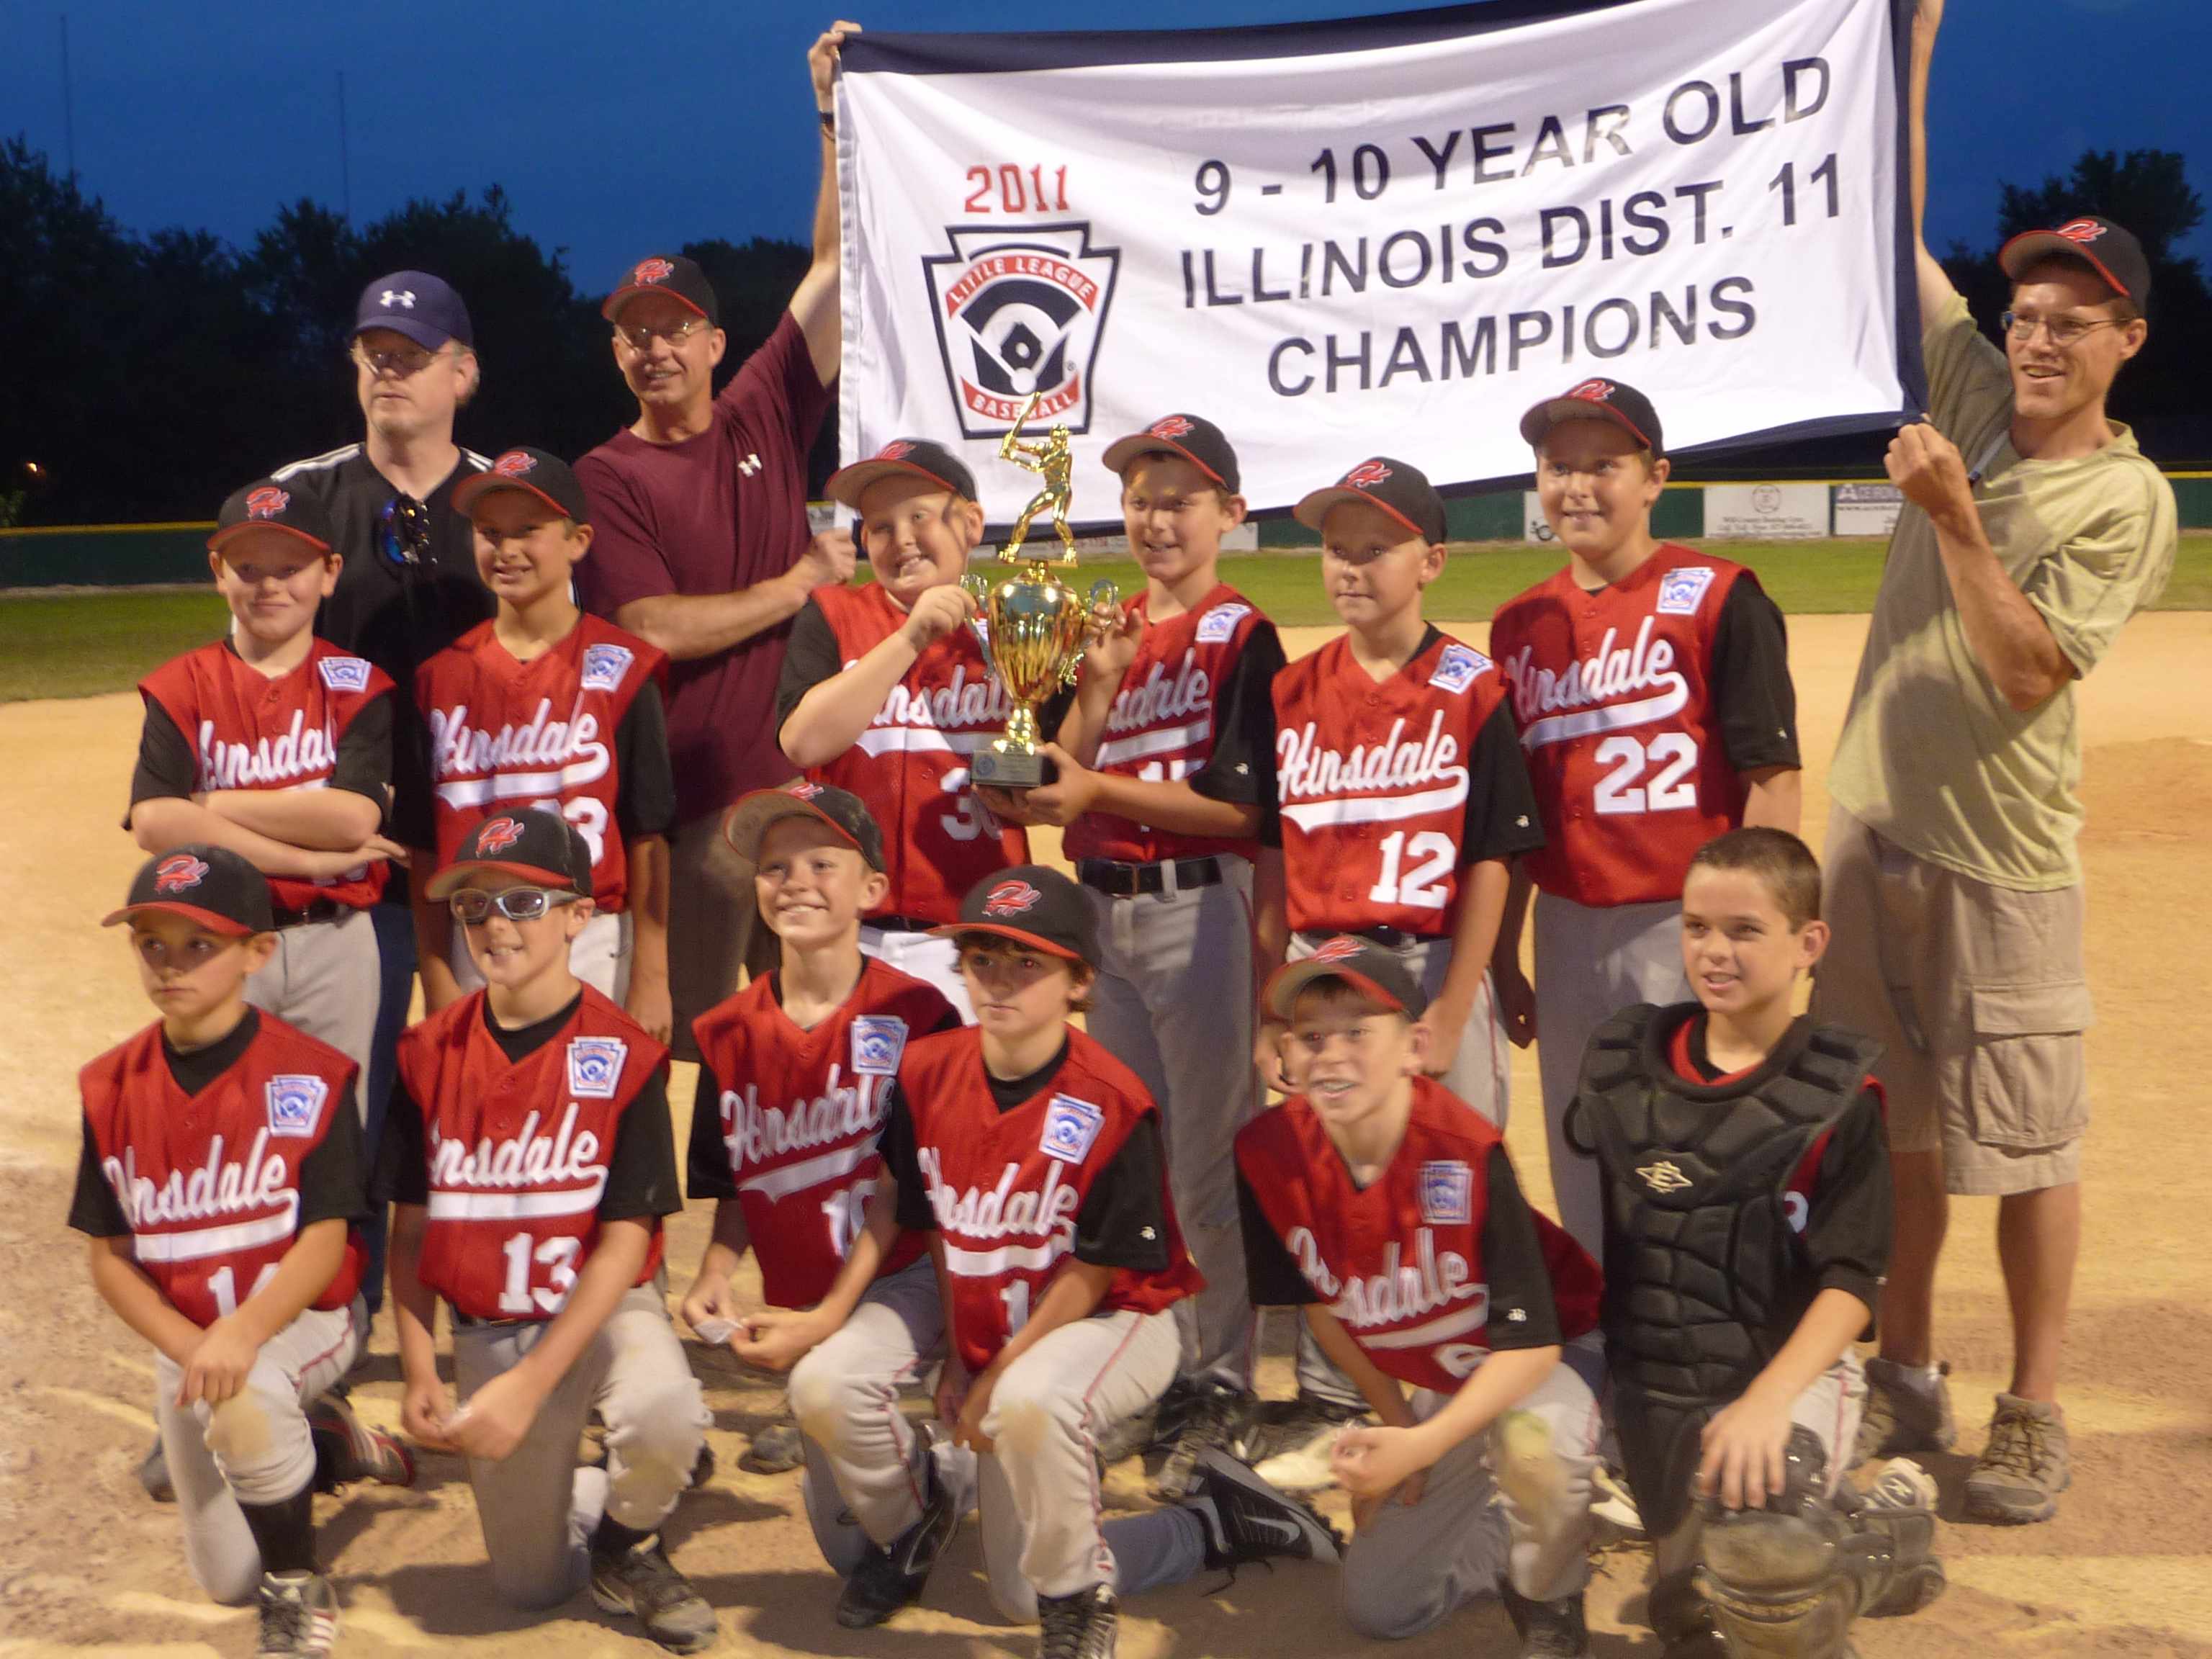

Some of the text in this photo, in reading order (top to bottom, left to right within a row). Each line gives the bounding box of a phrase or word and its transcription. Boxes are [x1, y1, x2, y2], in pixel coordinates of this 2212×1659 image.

[1195, 159, 1231, 216] 9
[1310, 143, 1390, 204] 10
[1410, 104, 1633, 190] YEAR
[1663, 56, 1830, 145] OLD
[964, 162, 1070, 213] 2011
[1181, 152, 1840, 309] ILLINOIS DIST. 11
[948, 256, 1094, 305] LITTLE LEAGUE
[1267, 276, 1757, 397] CHAMPIONS
[1505, 615, 1676, 723] Hinsdale
[1276, 709, 1462, 804] Hinsdale
[1593, 732, 1699, 814] 22
[1369, 830, 1456, 909] 12
[498, 1231, 583, 1315] 13
